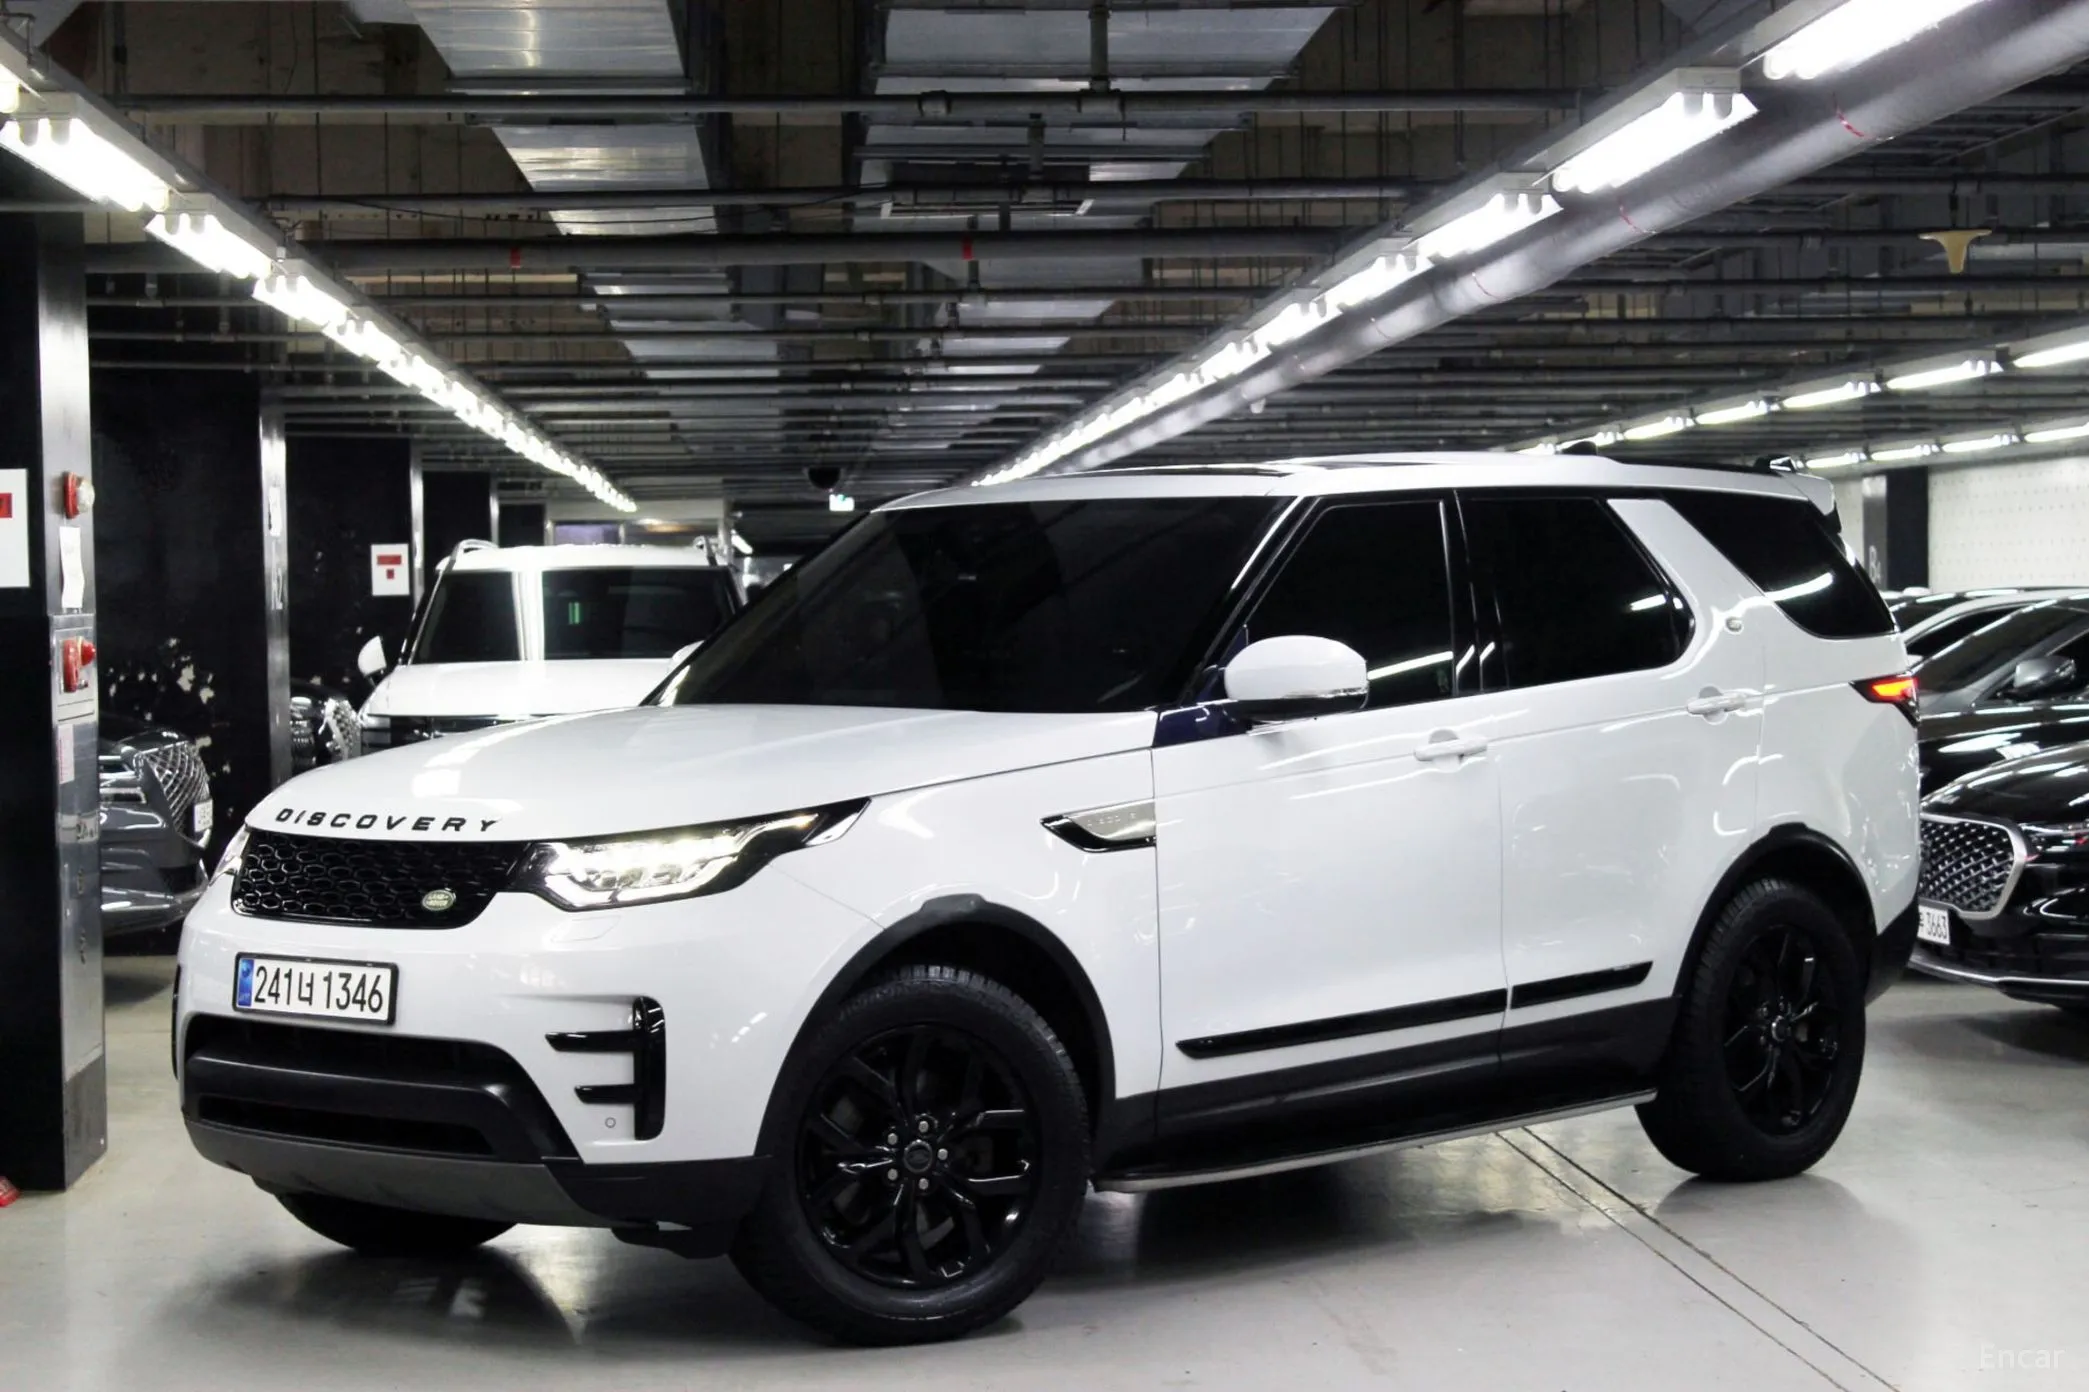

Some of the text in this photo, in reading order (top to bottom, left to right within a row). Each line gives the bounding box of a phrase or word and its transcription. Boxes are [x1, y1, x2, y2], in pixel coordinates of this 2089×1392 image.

[275, 808, 499, 832] DISCOVERY
[254, 965, 383, 1013] 241너 1346
